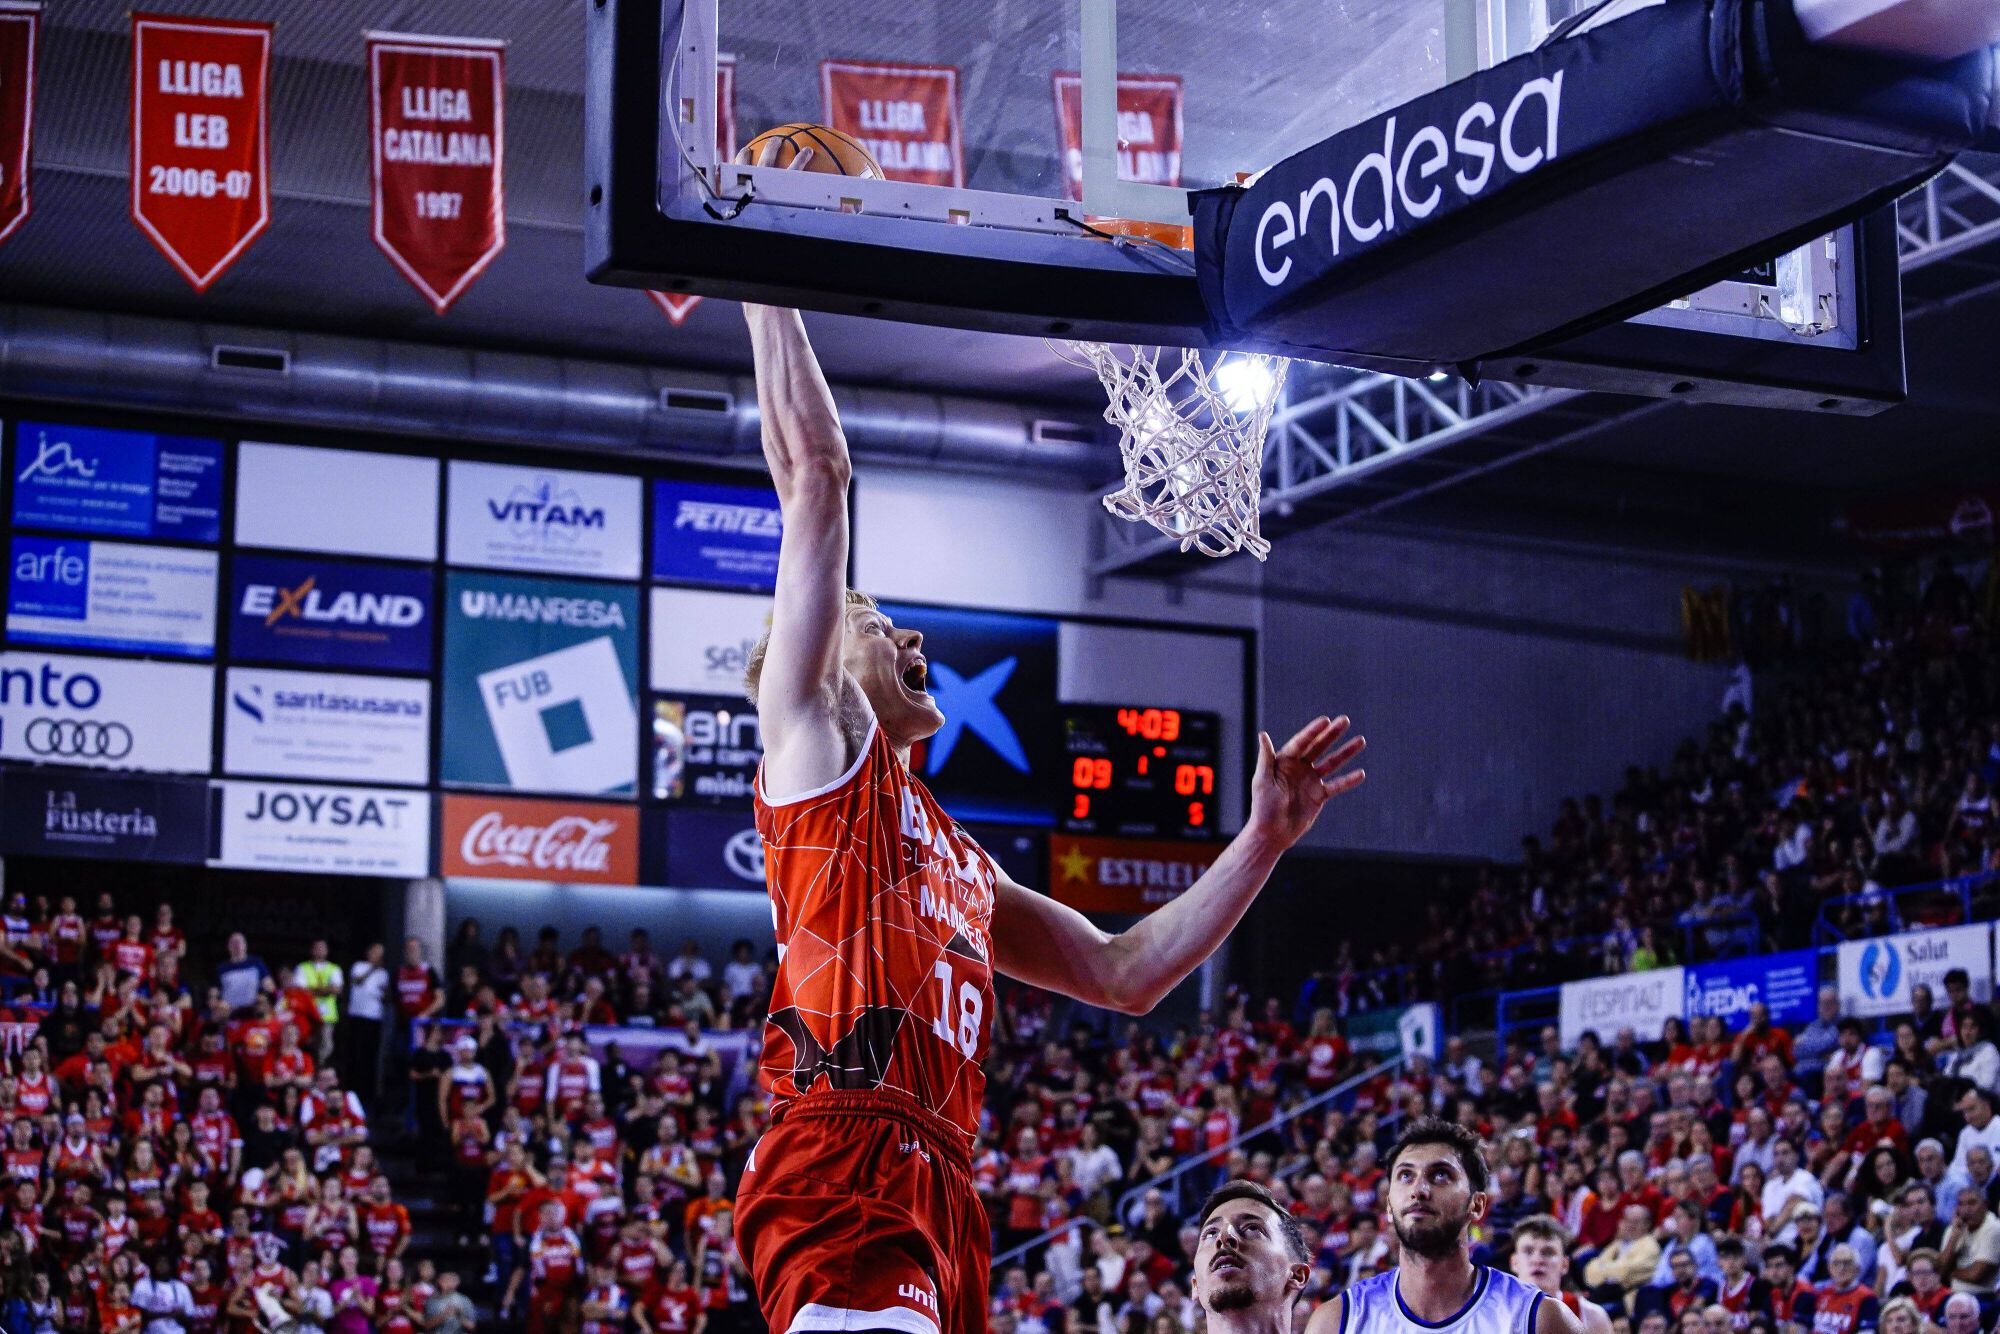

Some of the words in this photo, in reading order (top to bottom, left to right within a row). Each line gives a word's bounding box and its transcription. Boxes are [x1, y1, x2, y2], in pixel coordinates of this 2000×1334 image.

[159, 59, 244, 98] LLIGA
[402, 86, 471, 122] LLIGA
[859, 99, 927, 132] LLIGA
[174, 112, 229, 149] LEB
[384, 128, 493, 166] CATALANA
[150, 166, 252, 199] 2006-07
[1255, 70, 1564, 287] endesa
[415, 192, 463, 219] 1997
[487, 498, 605, 529] VITAM
[16, 546, 85, 587] arfe
[240, 575, 425, 628] EXLAND
[460, 590, 626, 630] UMANRESA
[273, 690, 422, 717] santasusana
[493, 669, 553, 709] FUB
[1117, 708, 1180, 741] 4:03
[1073, 757, 1112, 789] 09
[1175, 764, 1213, 795] 07
[45, 806, 158, 836] Fusteria
[246, 792, 409, 829] JOYSAT
[932, 960, 983, 1060] 18
